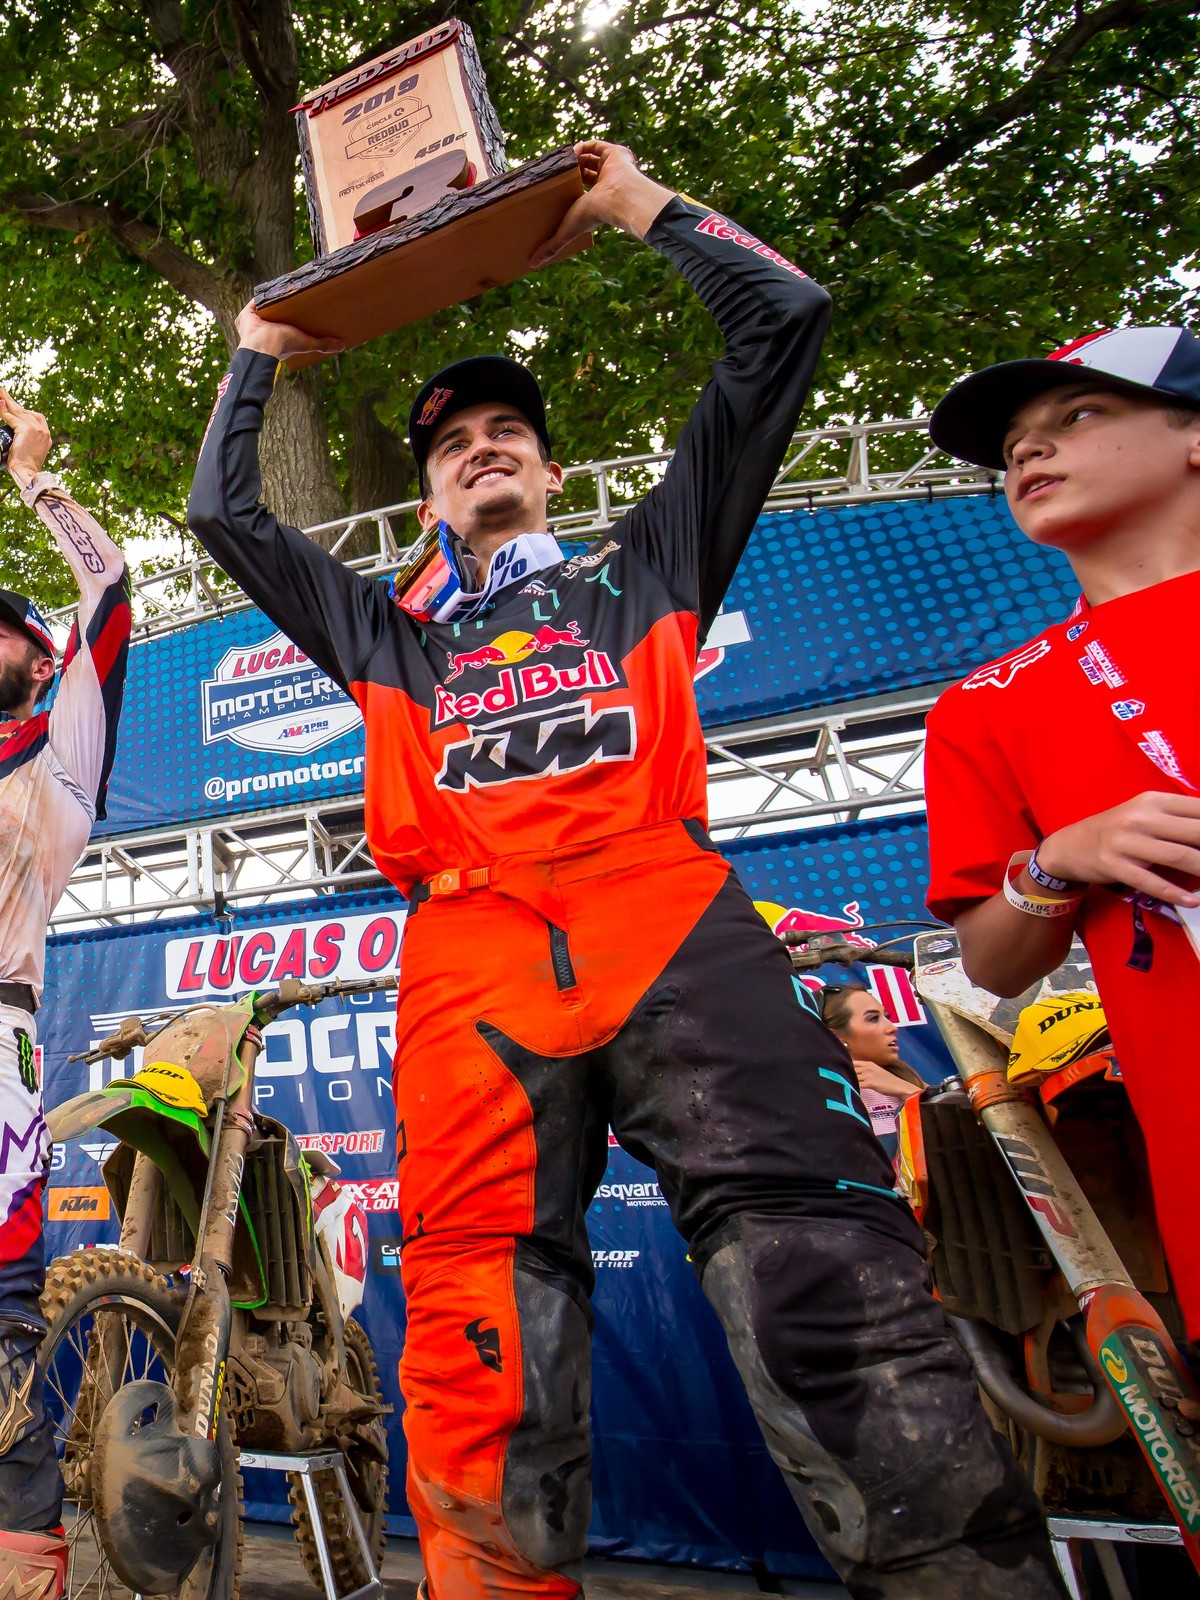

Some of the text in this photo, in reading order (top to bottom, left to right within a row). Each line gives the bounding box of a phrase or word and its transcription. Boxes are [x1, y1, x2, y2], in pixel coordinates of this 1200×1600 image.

[302, 24, 458, 118] REDBUD
[341, 73, 420, 126] 2019
[366, 114, 393, 130] CIRCLE
[366, 129, 413, 154] NATIONAL
[368, 119, 409, 146] REDBUD
[339, 171, 385, 198] MOTOCROSS
[435, 651, 620, 726] Red Bull
[1088, 640, 1125, 689] MOTOCROSS
[277, 719, 329, 740] AMA PRO
[435, 699, 637, 793] KTM
[177, 923, 346, 992] LUCAS
[59, 1195, 99, 1212] KTM
[1120, 1383, 1200, 1526] MOTOREX
